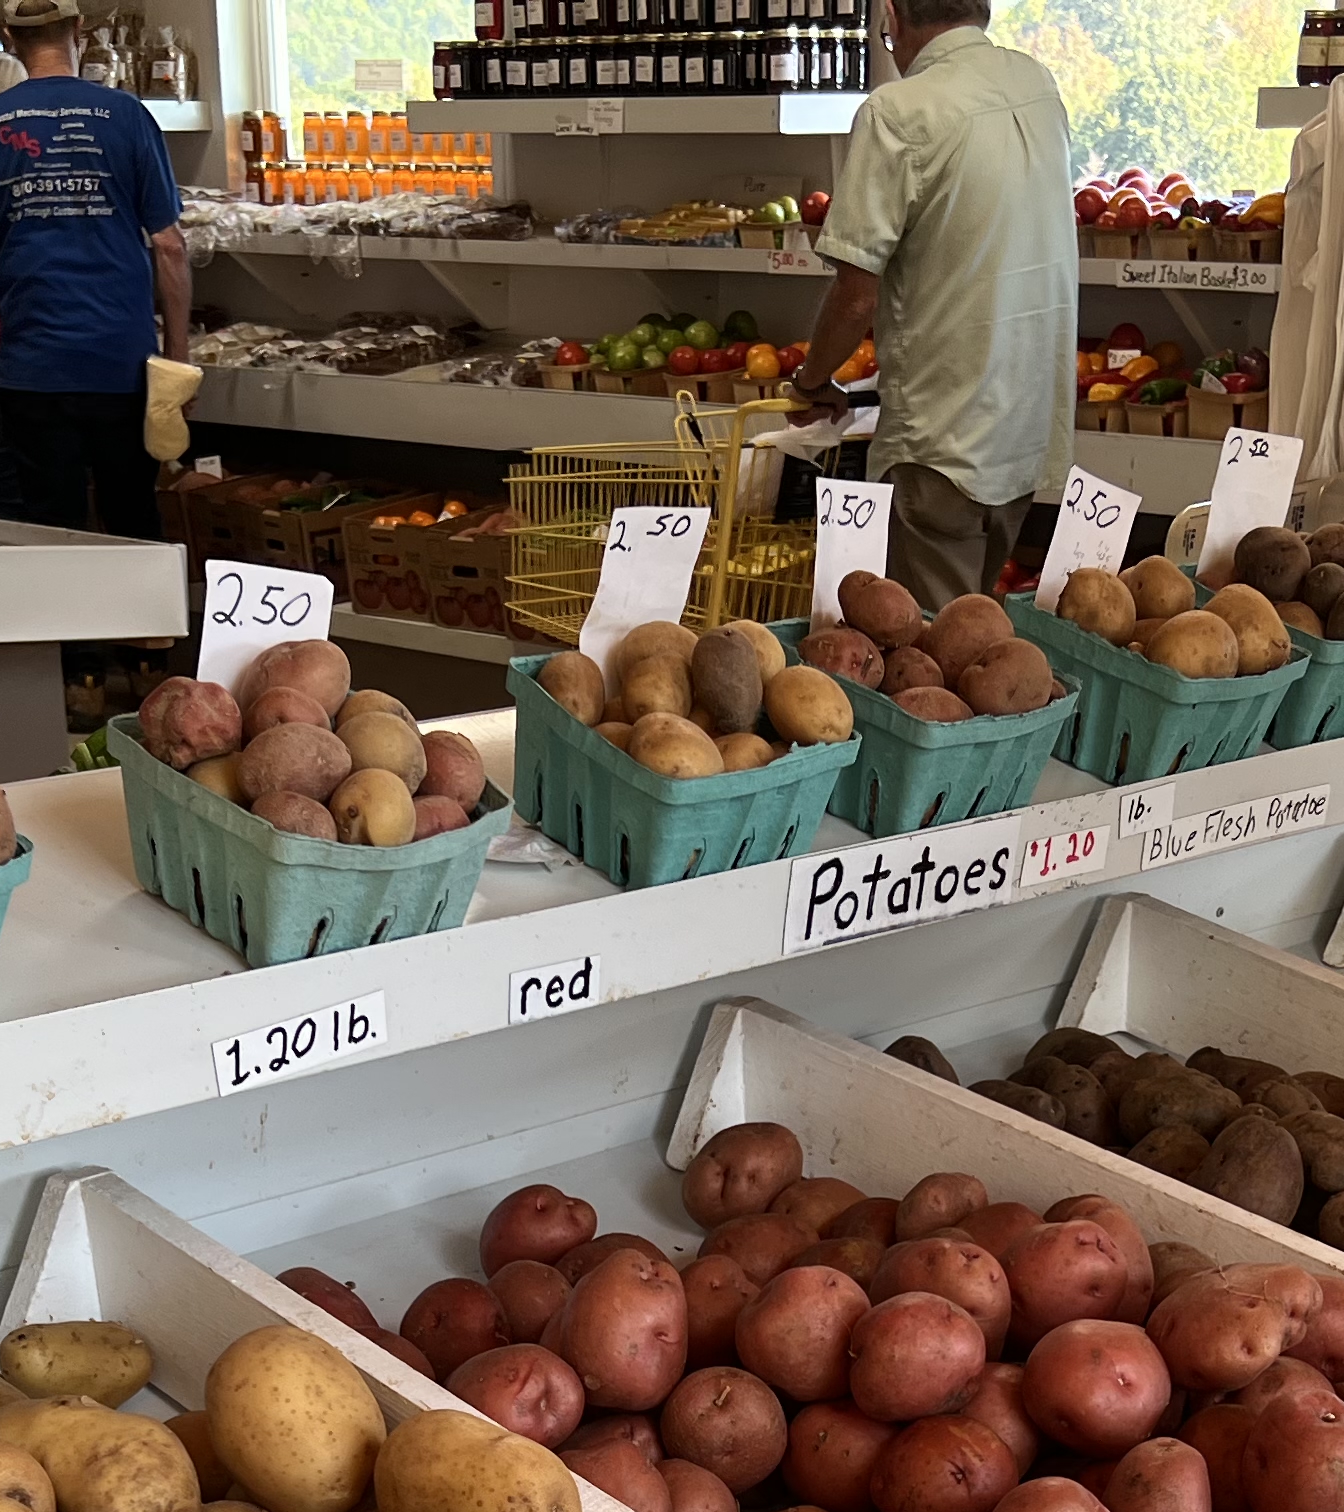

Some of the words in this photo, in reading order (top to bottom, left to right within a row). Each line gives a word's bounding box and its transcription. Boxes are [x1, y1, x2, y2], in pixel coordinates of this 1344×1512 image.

[819, 487, 877, 529] 2.50
[1066, 477, 1122, 529] 2.50
[211, 572, 313, 628] 2.50
[1148, 827, 1197, 863] Blue
[1202, 805, 1256, 843] Flesh
[804, 845, 1010, 942] Potatoes
[519, 956, 594, 1016] red
[225, 1016, 318, 1087] 1.20
[332, 1001, 378, 1052] lb.
